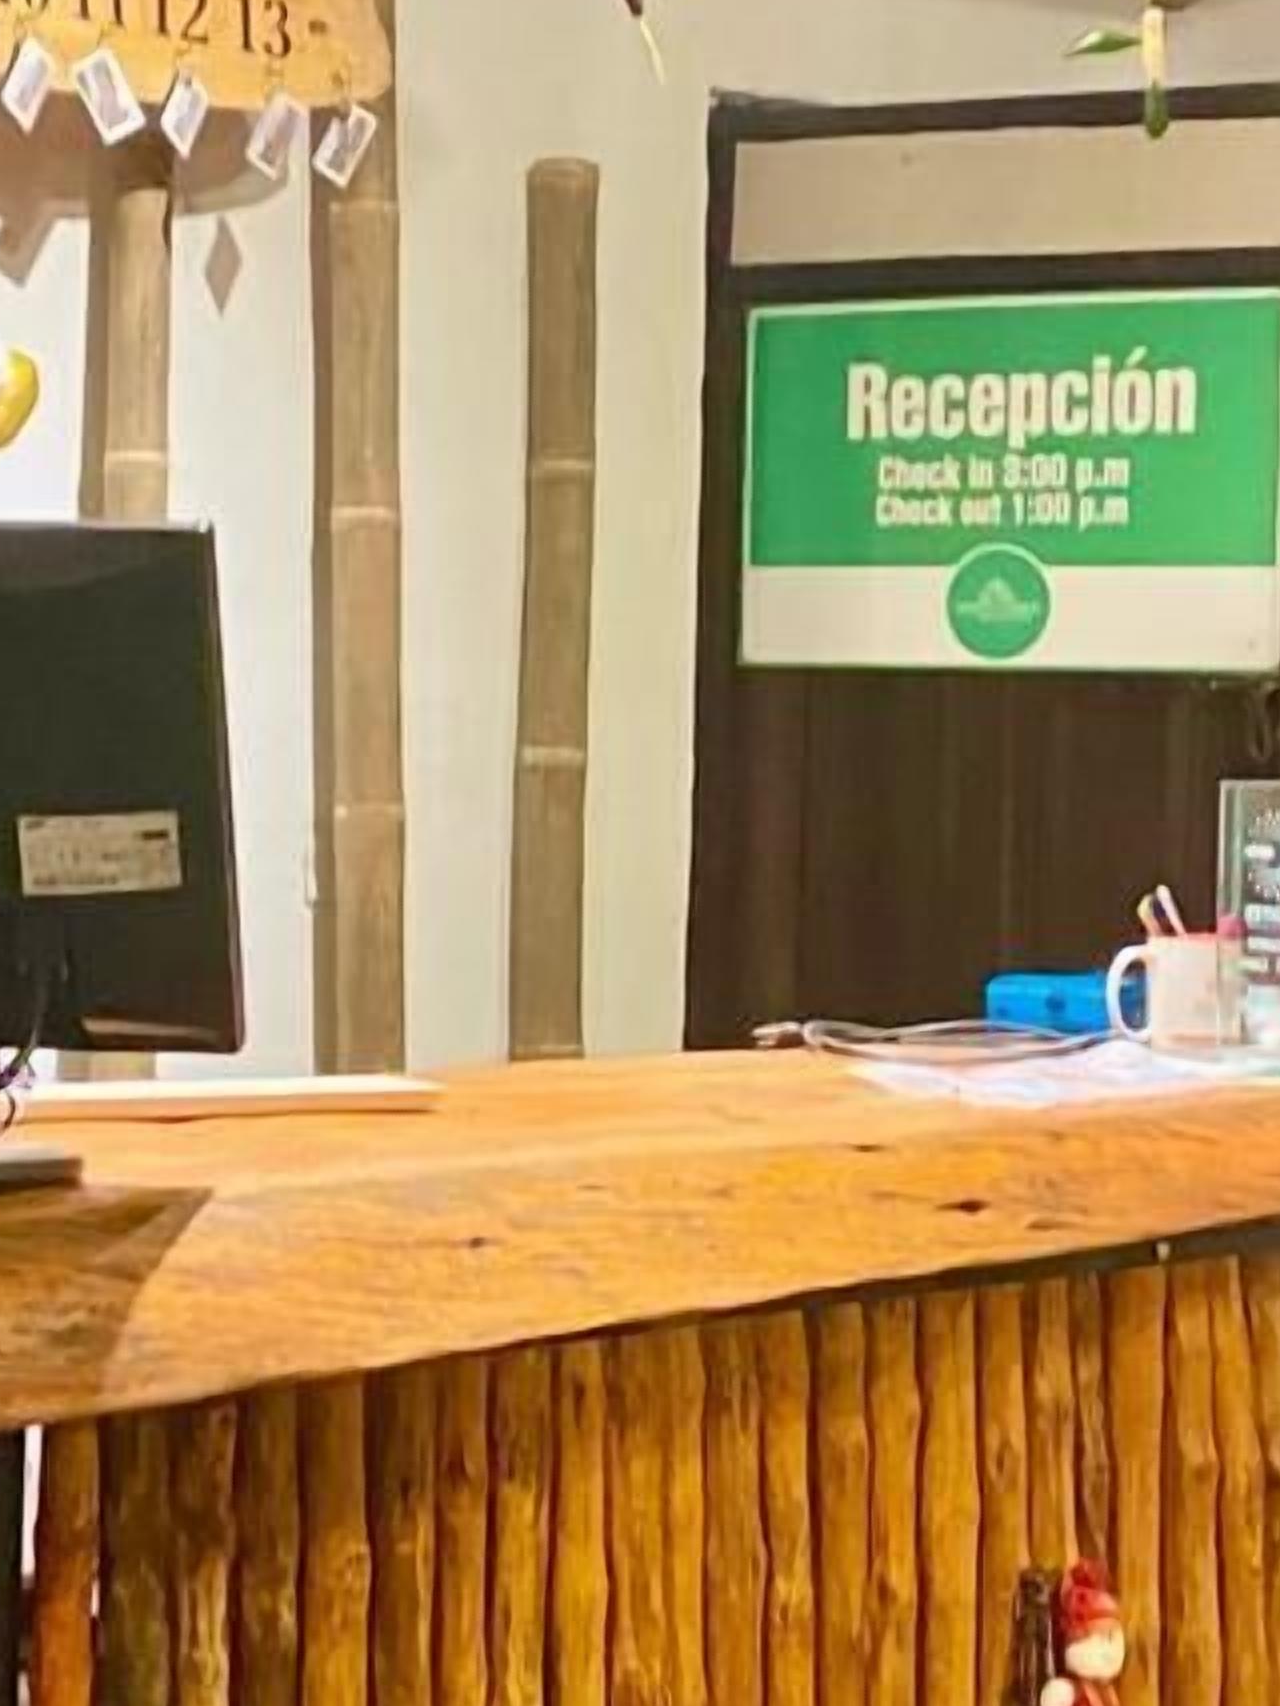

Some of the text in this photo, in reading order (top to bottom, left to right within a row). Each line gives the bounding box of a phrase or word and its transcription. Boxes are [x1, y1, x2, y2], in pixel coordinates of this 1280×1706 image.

[846, 344, 1198, 449] Recepción
[878, 453, 962, 491] Check
[967, 453, 994, 489] in
[1074, 456, 1131, 494] p.m
[875, 490, 1130, 532] Check out 1:00 p.m
